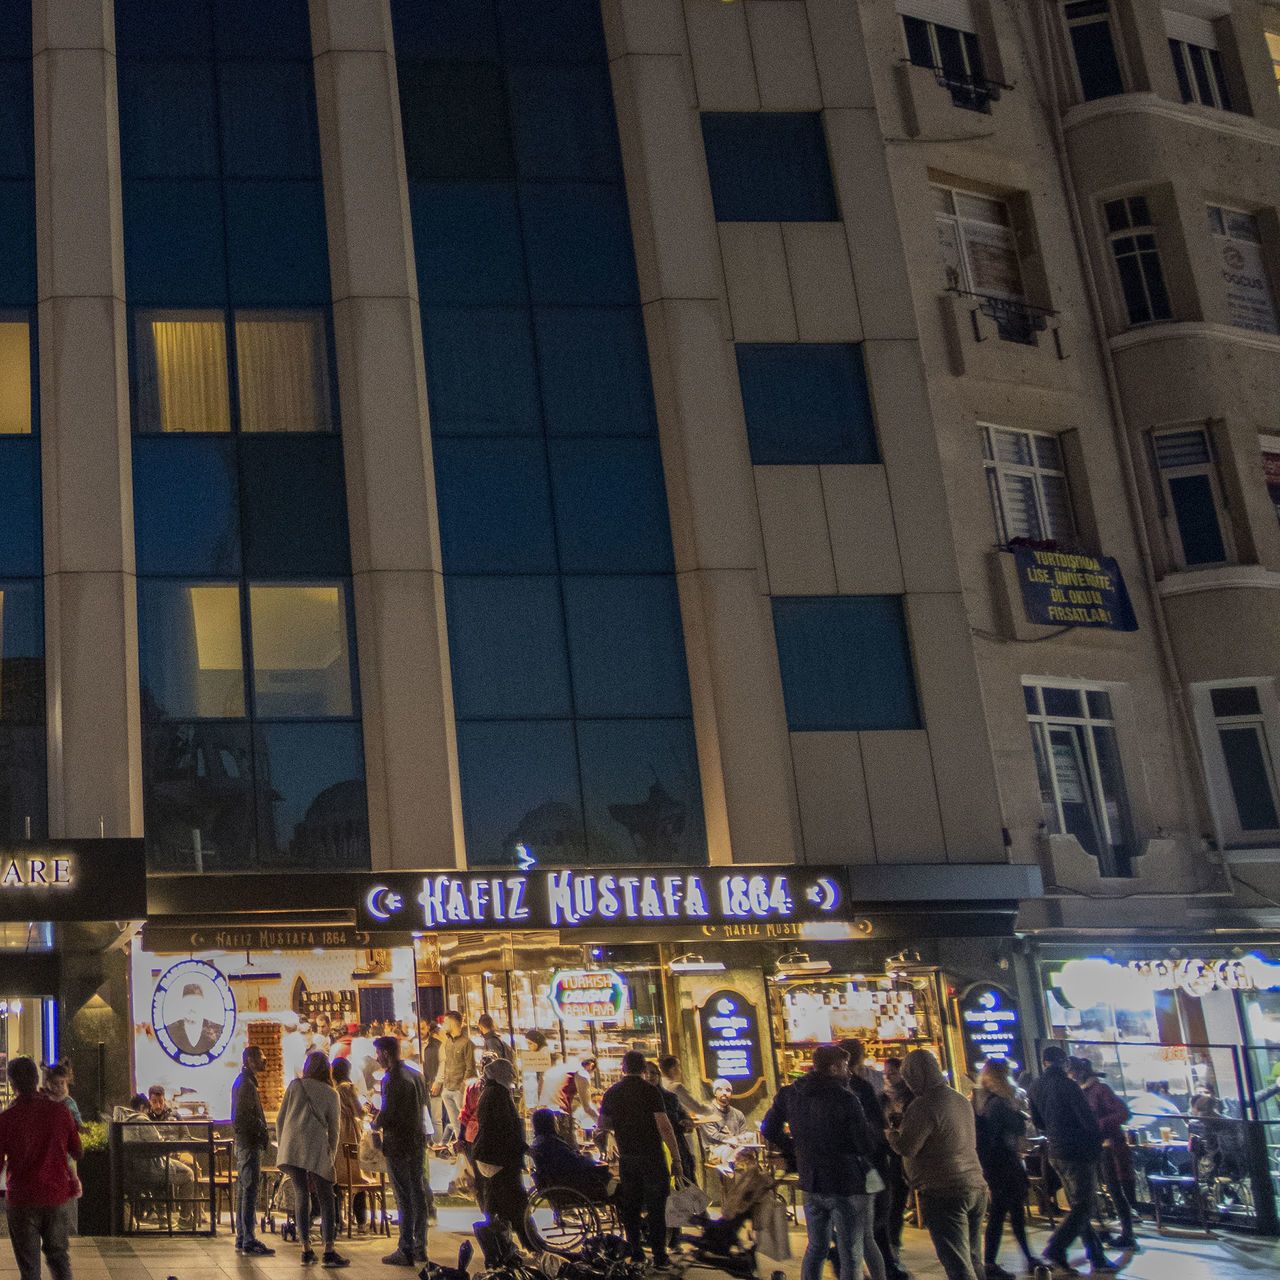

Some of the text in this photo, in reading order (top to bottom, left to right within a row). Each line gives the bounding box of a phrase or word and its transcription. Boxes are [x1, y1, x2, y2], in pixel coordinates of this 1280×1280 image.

[418, 871, 792, 926] HAFIZ MUSTAFA 1864
[723, 923, 760, 937] HAFIZ
[216, 931, 347, 948] HAFIZ MUSTAFA 1864
[564, 1003, 615, 1017] BAKLAVA
